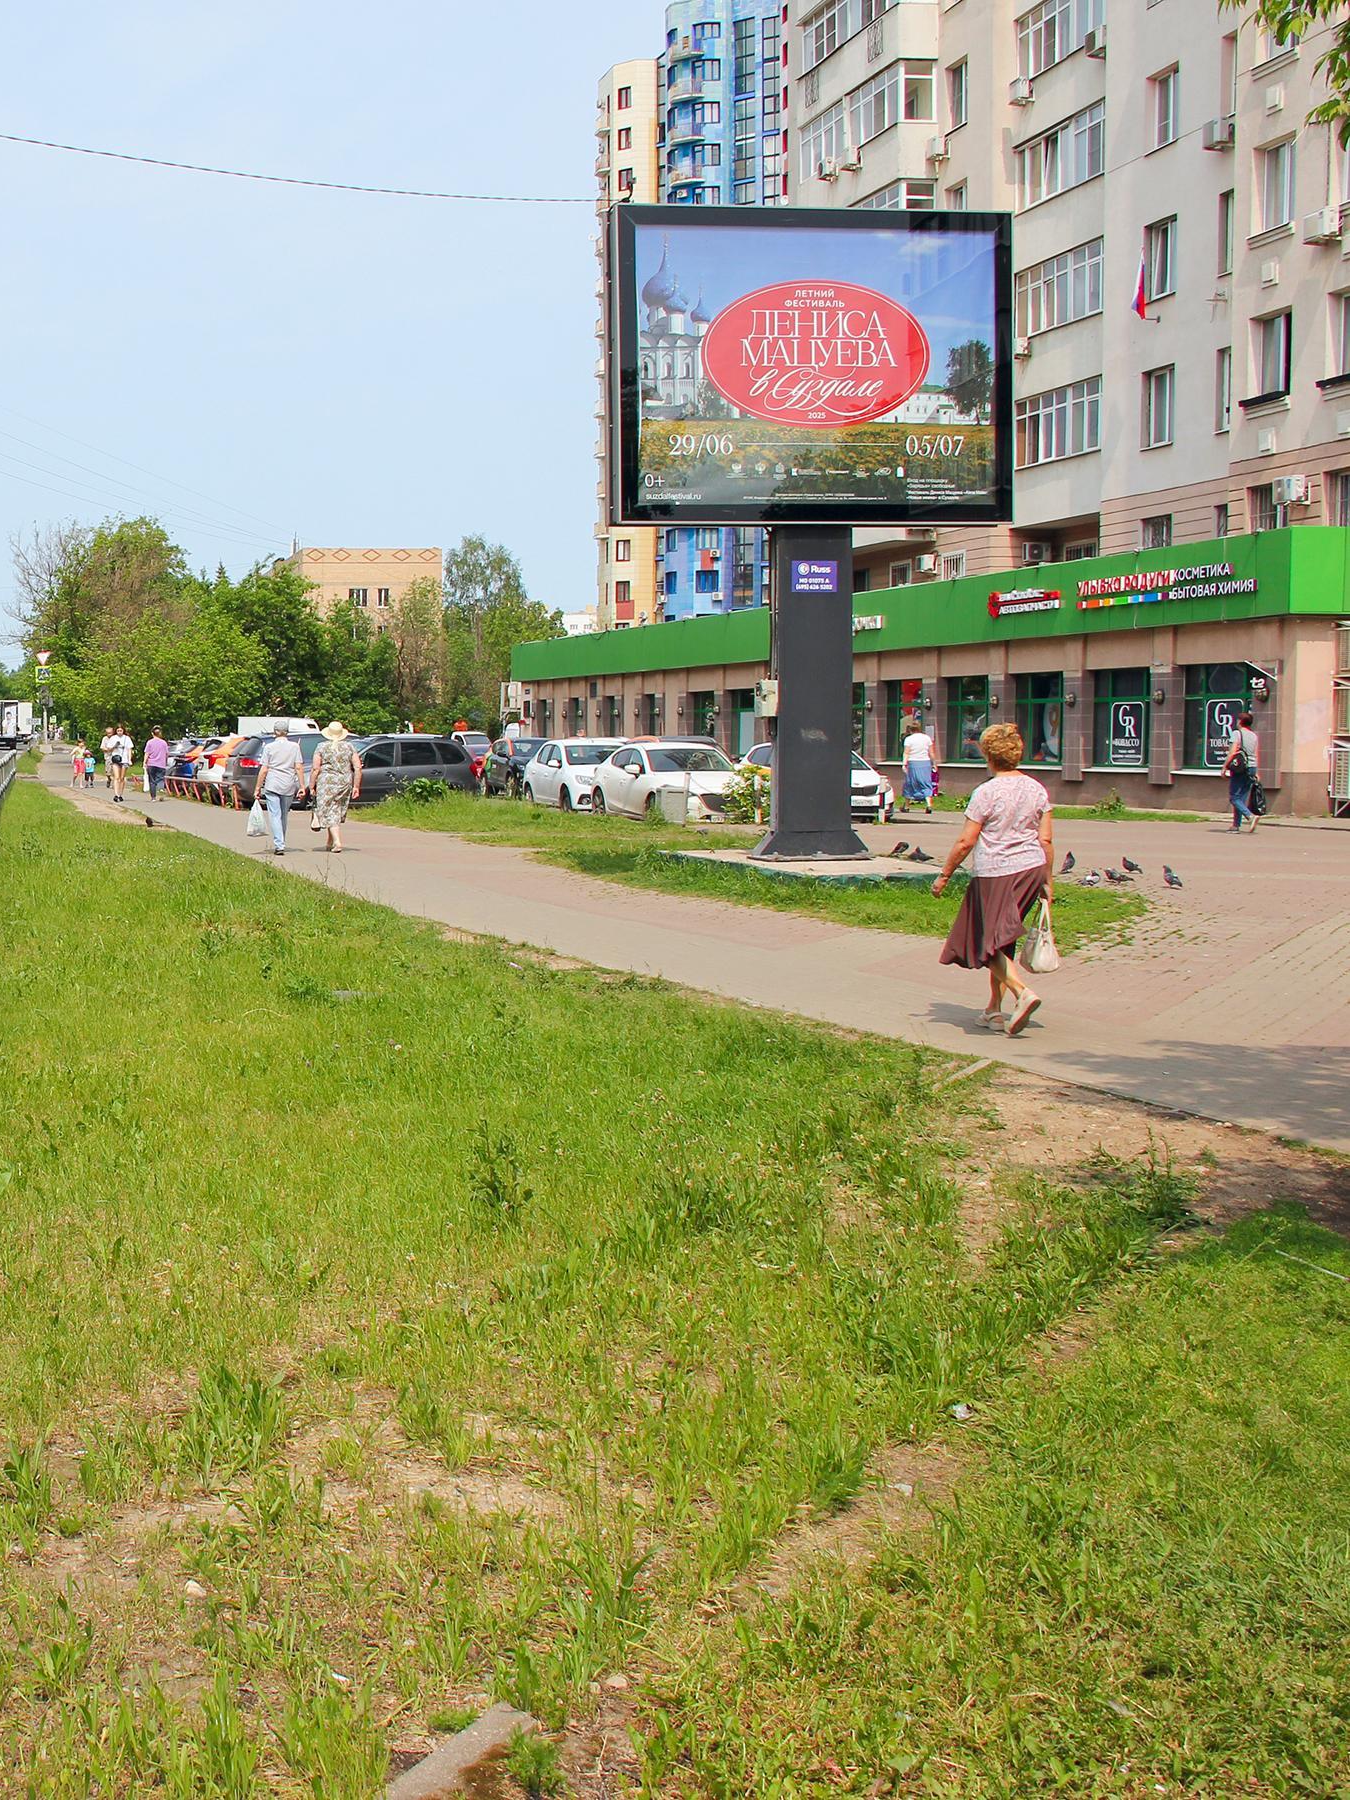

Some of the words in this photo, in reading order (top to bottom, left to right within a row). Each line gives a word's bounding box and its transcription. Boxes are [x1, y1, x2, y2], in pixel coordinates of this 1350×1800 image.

[784, 299, 845, 308] ФЕСТИВАЛЬ
[794, 289, 835, 298] ЛЕТНИЙ
[748, 309, 887, 341] ДЕНИСА
[740, 338, 898, 371] МАЦУЕВА
[749, 367, 778, 397] в
[763, 367, 884, 415] Суздале
[668, 434, 734, 459] 29/06
[905, 434, 965, 460] 05/07
[644, 473, 666, 487] 0+
[645, 492, 702, 501] suzdalfestival.ru
[810, 565, 831, 574] Russ
[1172, 563, 1231, 581] КОСМЕТИКА
[1171, 583, 1216, 600] БЫТОВАЯ
[1217, 578, 1254, 595] ХИМИЯ
[1210, 738, 1231, 747] TOBAC
